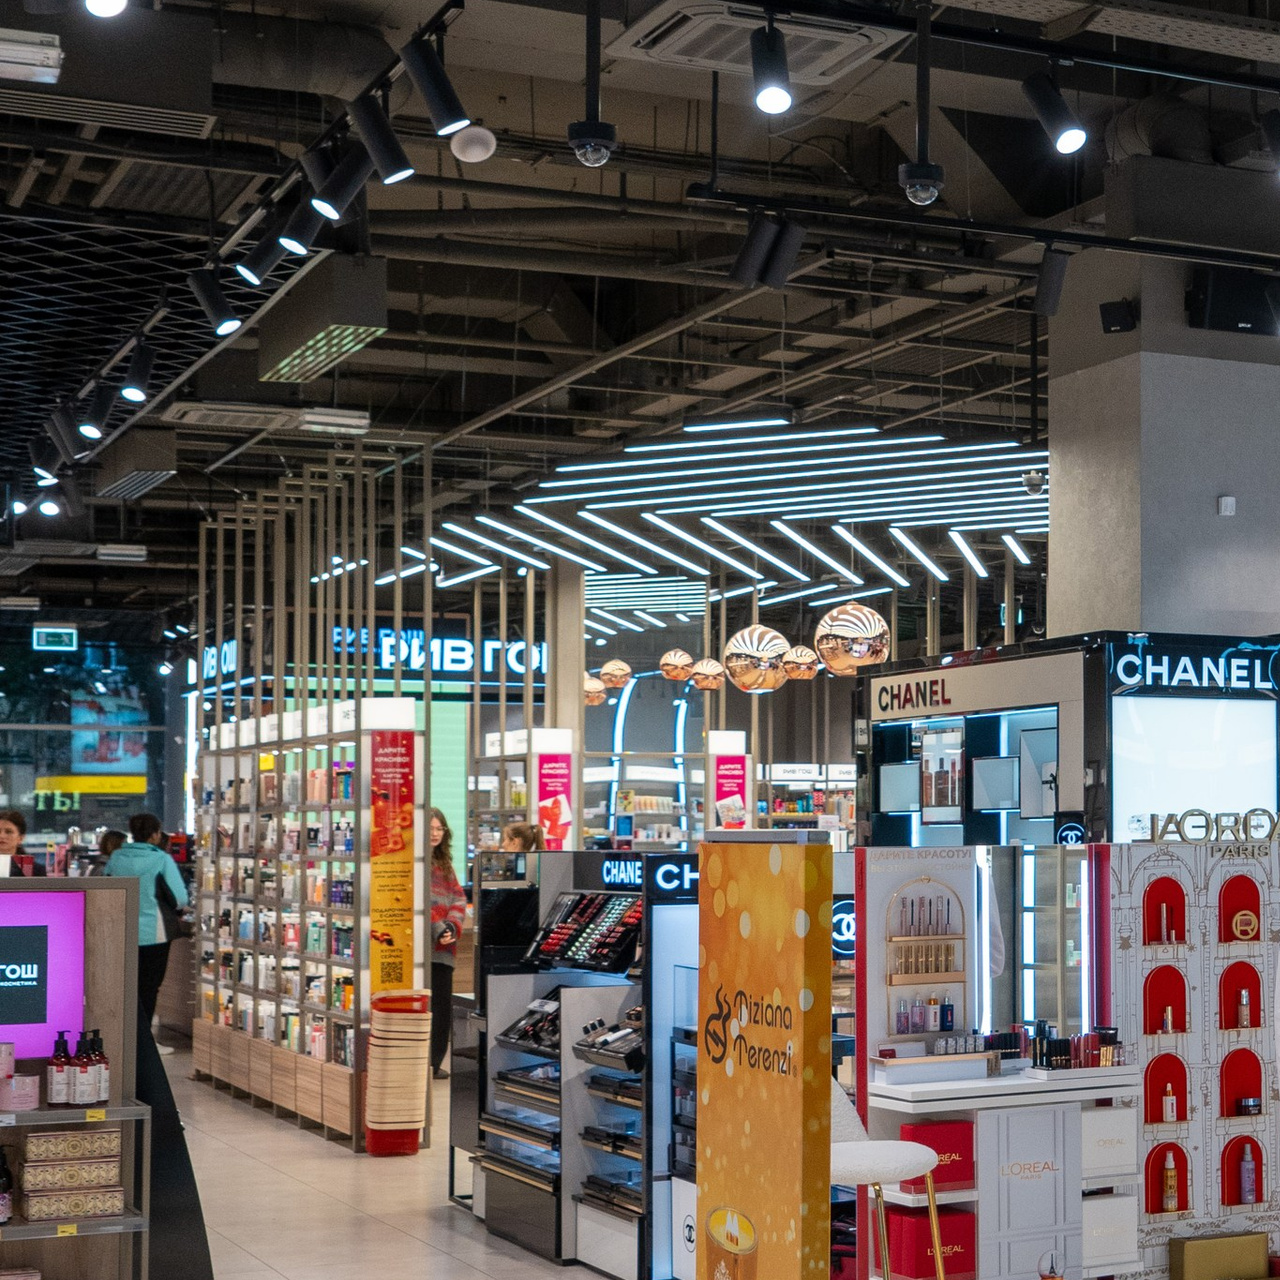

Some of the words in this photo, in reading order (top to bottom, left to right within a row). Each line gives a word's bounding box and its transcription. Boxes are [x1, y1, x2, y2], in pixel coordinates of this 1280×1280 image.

[381, 636, 474, 671] РИВ
[1116, 654, 1273, 689] CHANEL
[878, 678, 951, 712] CHANEL
[1210, 844, 1271, 858] PARIS
[603, 860, 642, 884] CHANE
[734, 990, 792, 1030] Tiziana
[733, 1034, 791, 1076] Terenzi
